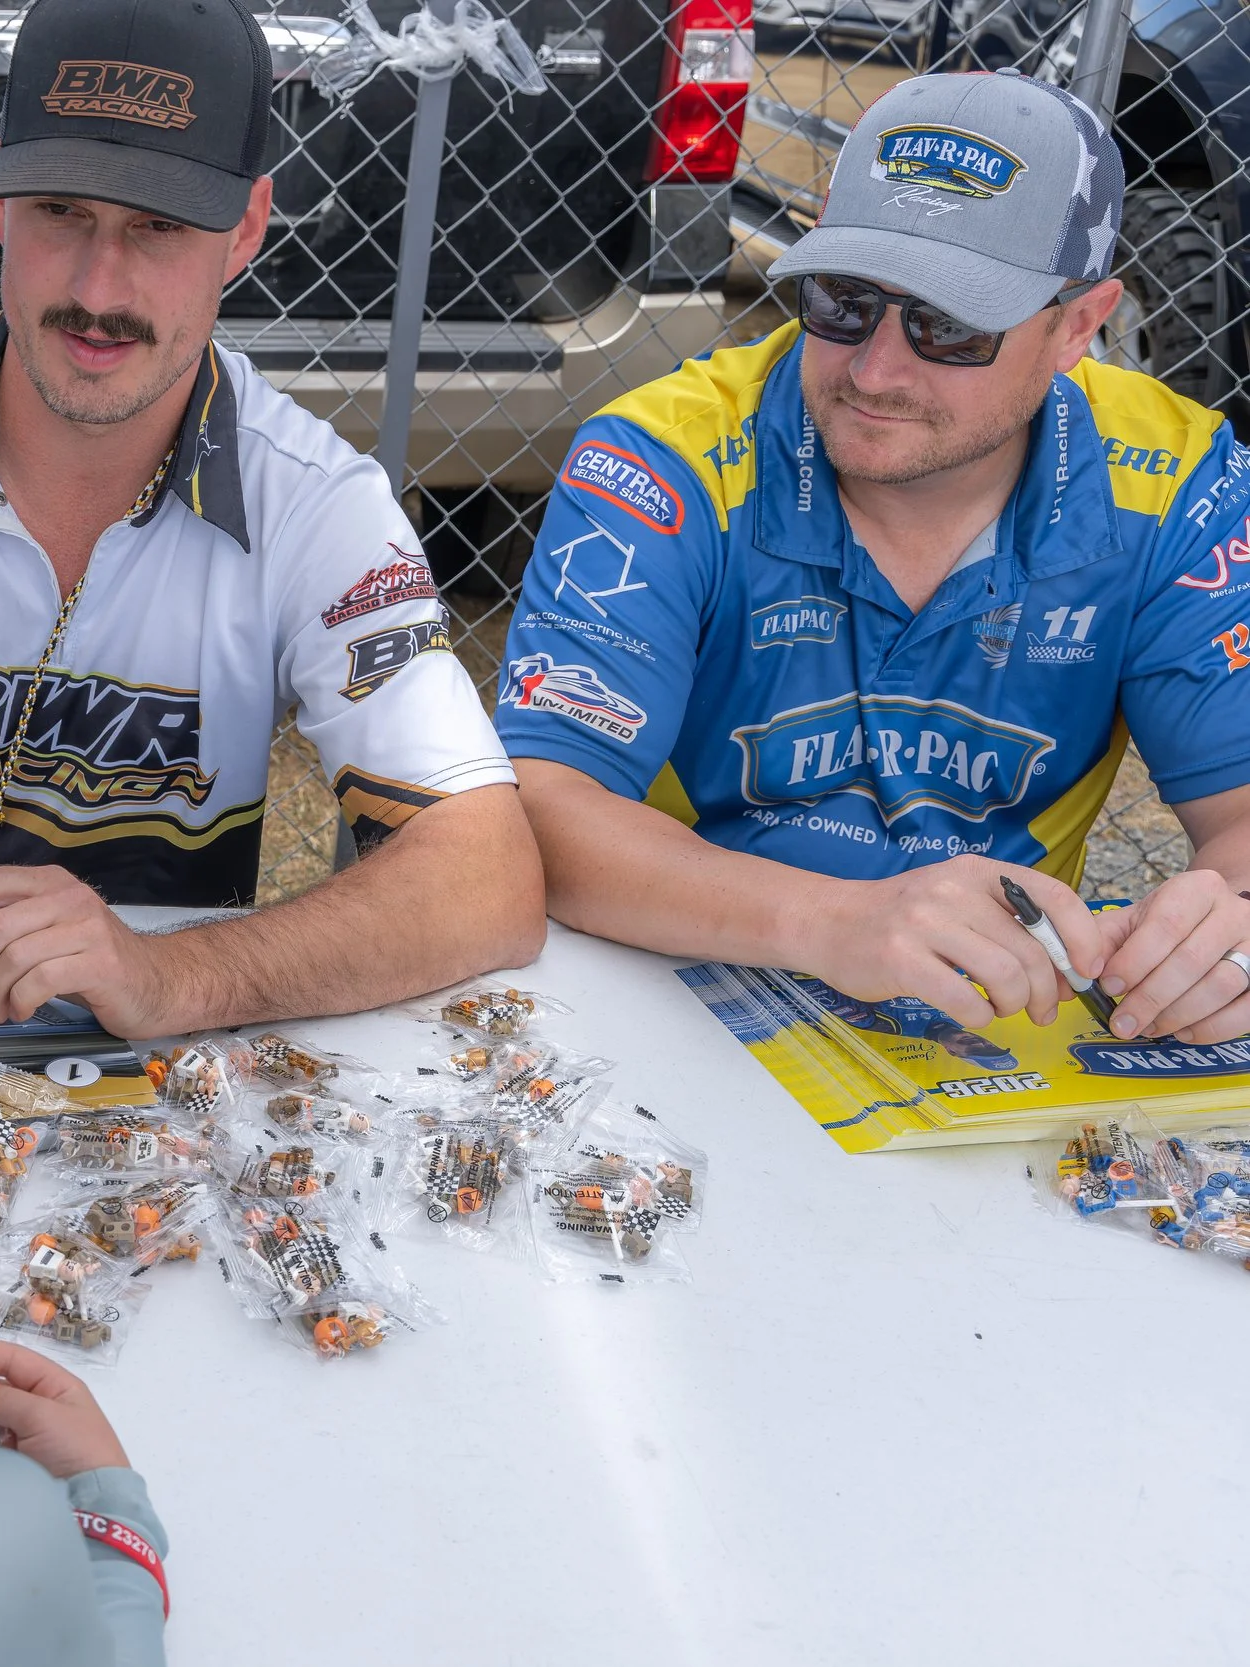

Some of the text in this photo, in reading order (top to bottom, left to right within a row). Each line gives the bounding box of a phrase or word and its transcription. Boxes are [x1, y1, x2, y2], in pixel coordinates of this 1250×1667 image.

[50, 63, 190, 110] BWR
[63, 100, 169, 122] RACING
[882, 185, 964, 216] Racing
[571, 467, 670, 522] WELDING SUPPLY
[576, 449, 671, 514] CENTRAL
[324, 567, 435, 614] KENNER
[1209, 584, 1237, 599] Metal
[327, 595, 381, 627] RACING
[1043, 606, 1097, 641] 11
[582, 632, 610, 645] WORK
[1056, 646, 1097, 660] URG
[532, 695, 634, 740] UNLIMITED
[808, 816, 877, 845] OWNED
[885, 1043, 935, 1053] Nilsen
[897, 1050, 937, 1062] Jamie
[495, 1065, 537, 1097] WARNING:
[937, 1071, 1052, 1099] 2026
[71, 1132, 129, 1145] WARNING:
[1107, 1120, 1125, 1159] ATTENTION:
[427, 1135, 444, 1183] WARNING:
[466, 1135, 485, 1188] ATTENTION:
[556, 1221, 613, 1234] WARNING:
[285, 1237, 315, 1293] ATTENTION:
[111, 1524, 157, 1565] 23270
